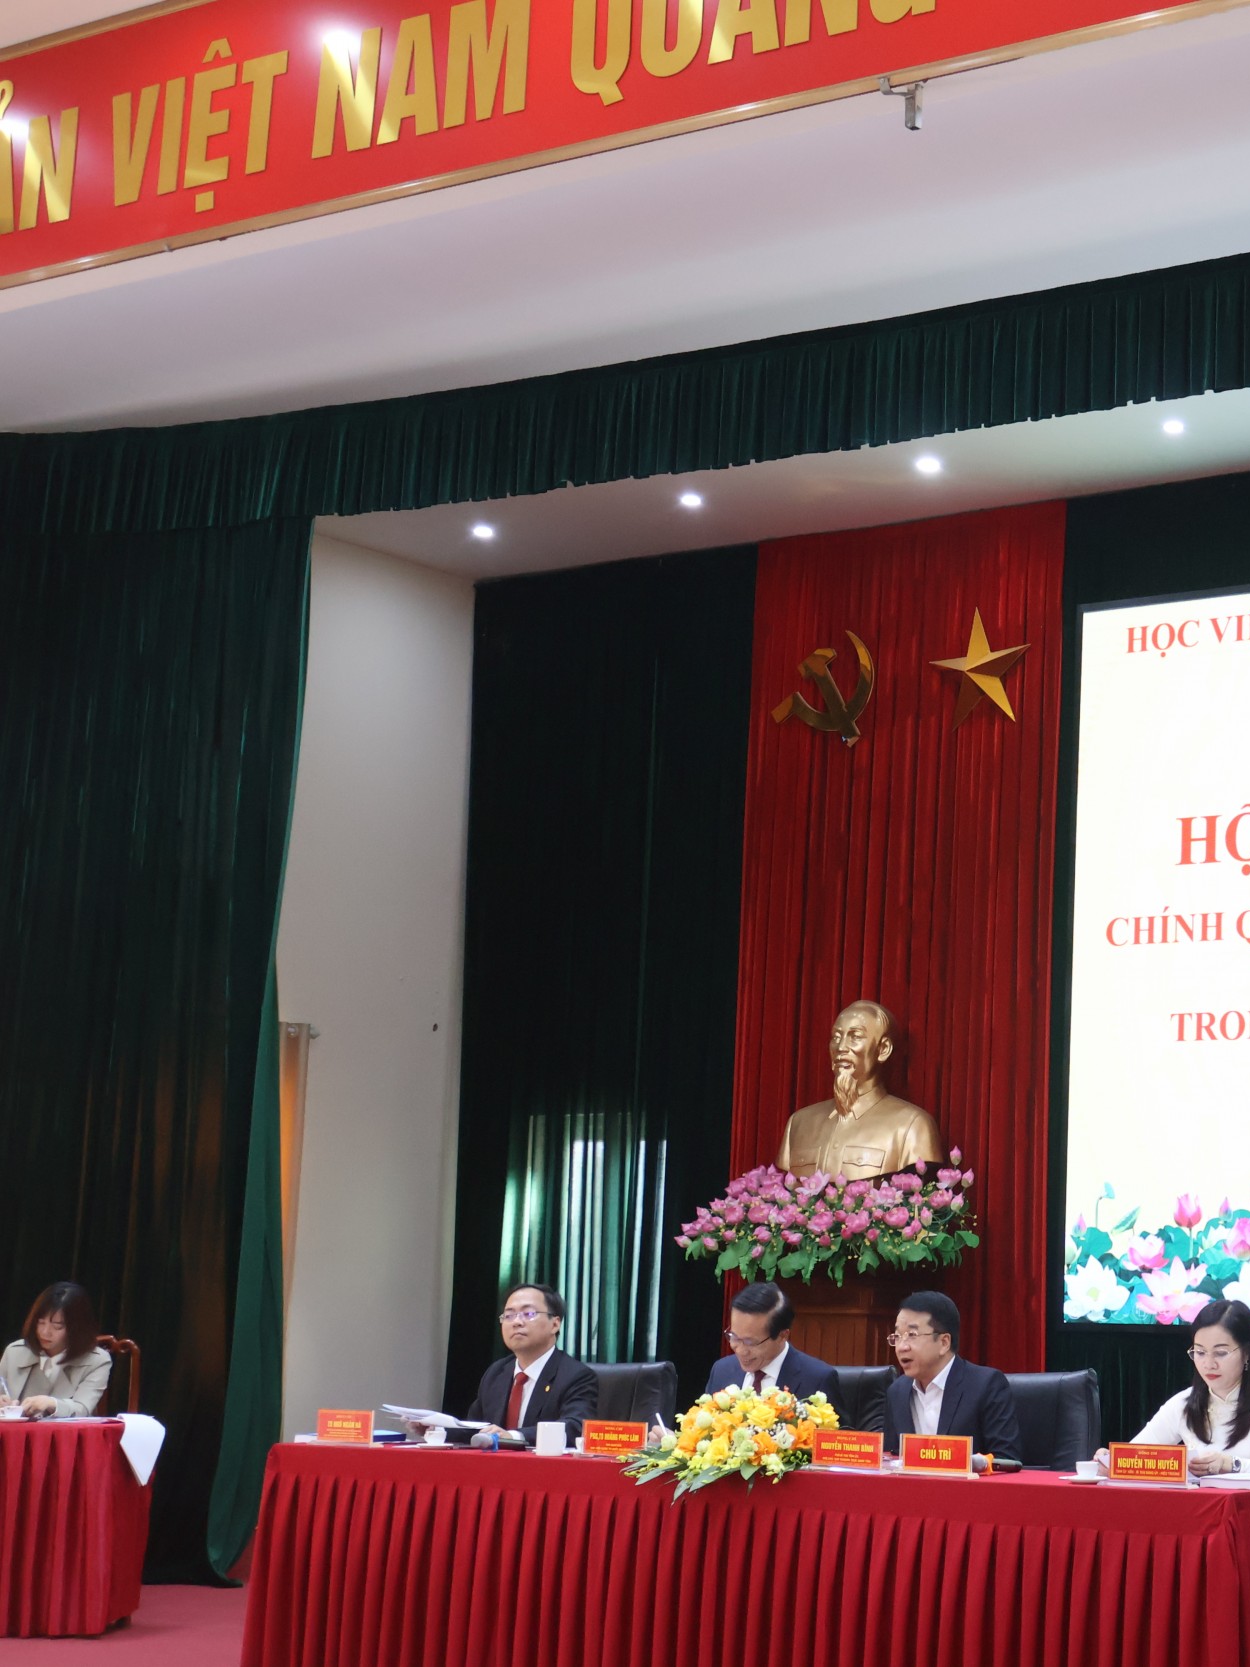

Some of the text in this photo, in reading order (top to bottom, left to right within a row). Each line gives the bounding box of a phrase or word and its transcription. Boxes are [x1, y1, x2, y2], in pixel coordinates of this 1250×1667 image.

[112, 37, 289, 213] VIỆT
[311, 0, 531, 159] NAM
[1126, 619, 1201, 659] HỌC
[1105, 905, 1224, 947] CHÍNH
[920, 1444, 952, 1460] CHỦ TRÌ
[1144, 1458, 1156, 1469] THU
